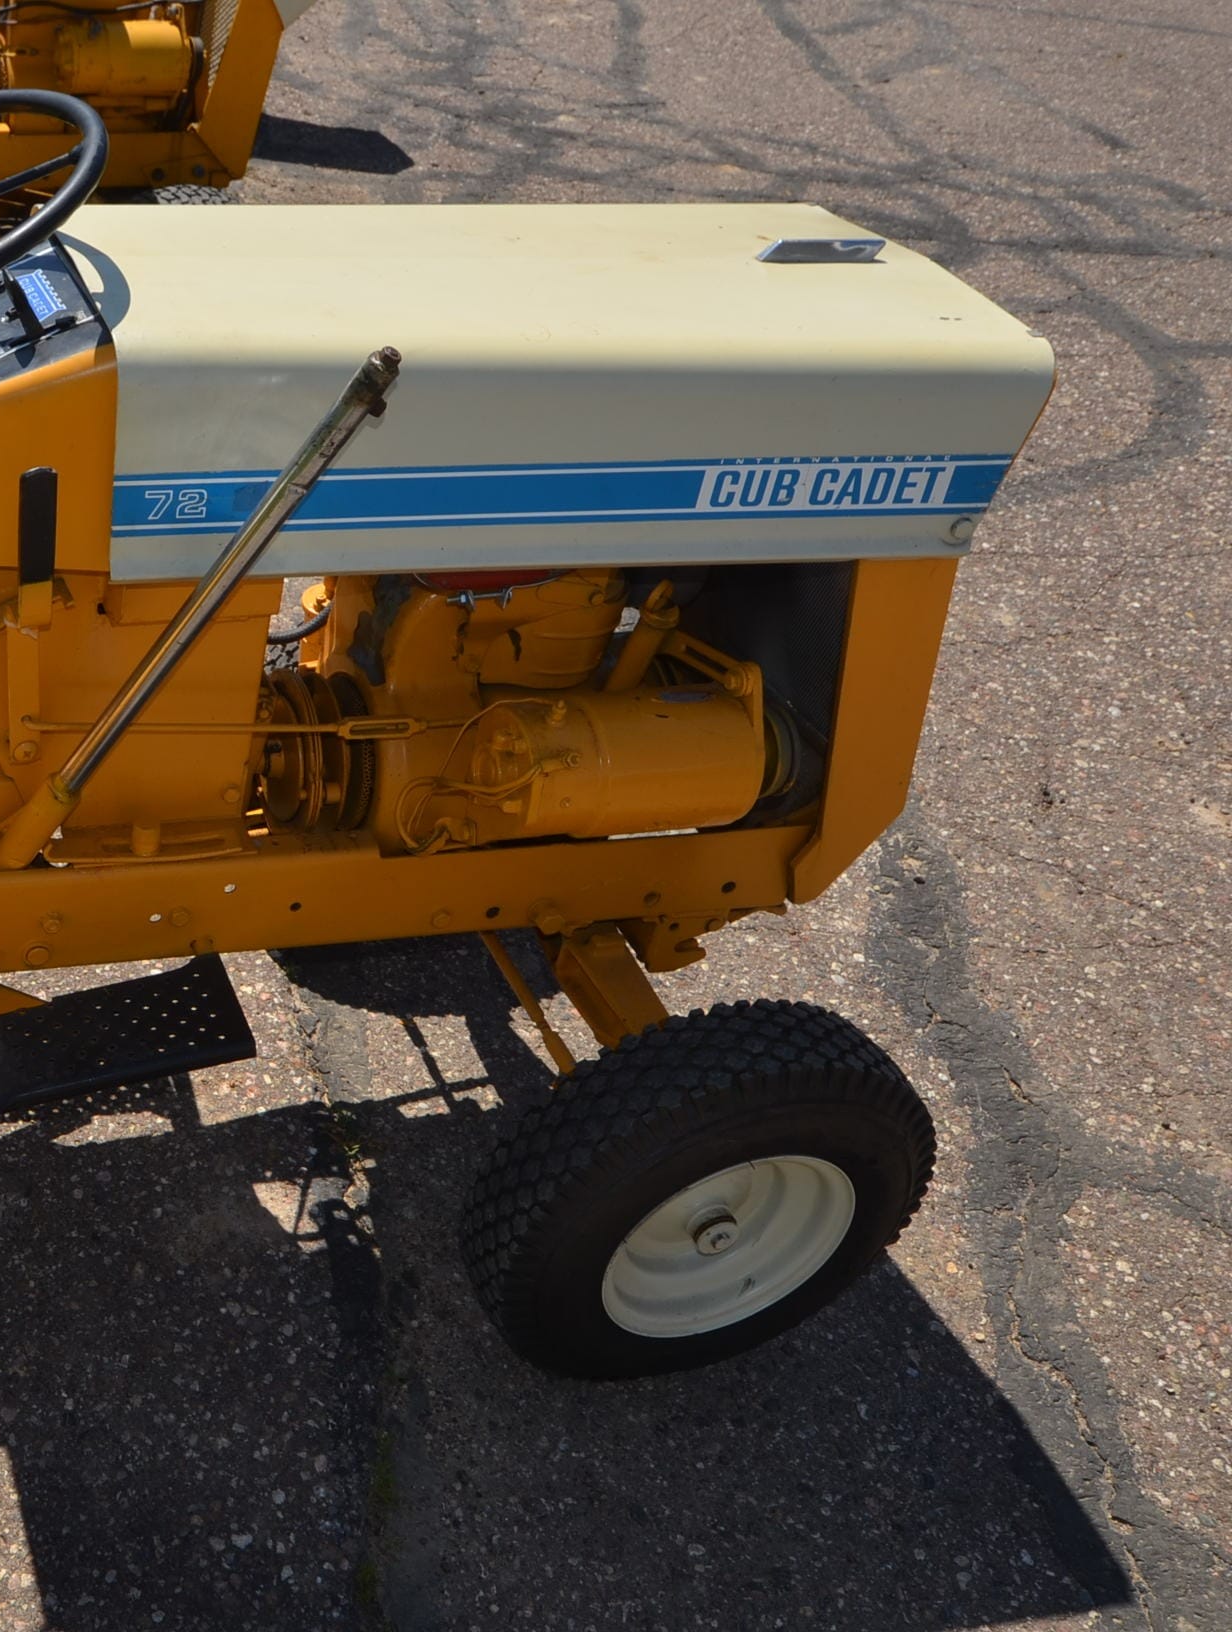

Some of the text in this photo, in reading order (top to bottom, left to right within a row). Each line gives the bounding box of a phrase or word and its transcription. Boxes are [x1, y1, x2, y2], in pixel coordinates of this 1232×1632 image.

[144, 488, 208, 520] 72
[709, 466, 948, 507] CUB CADET
